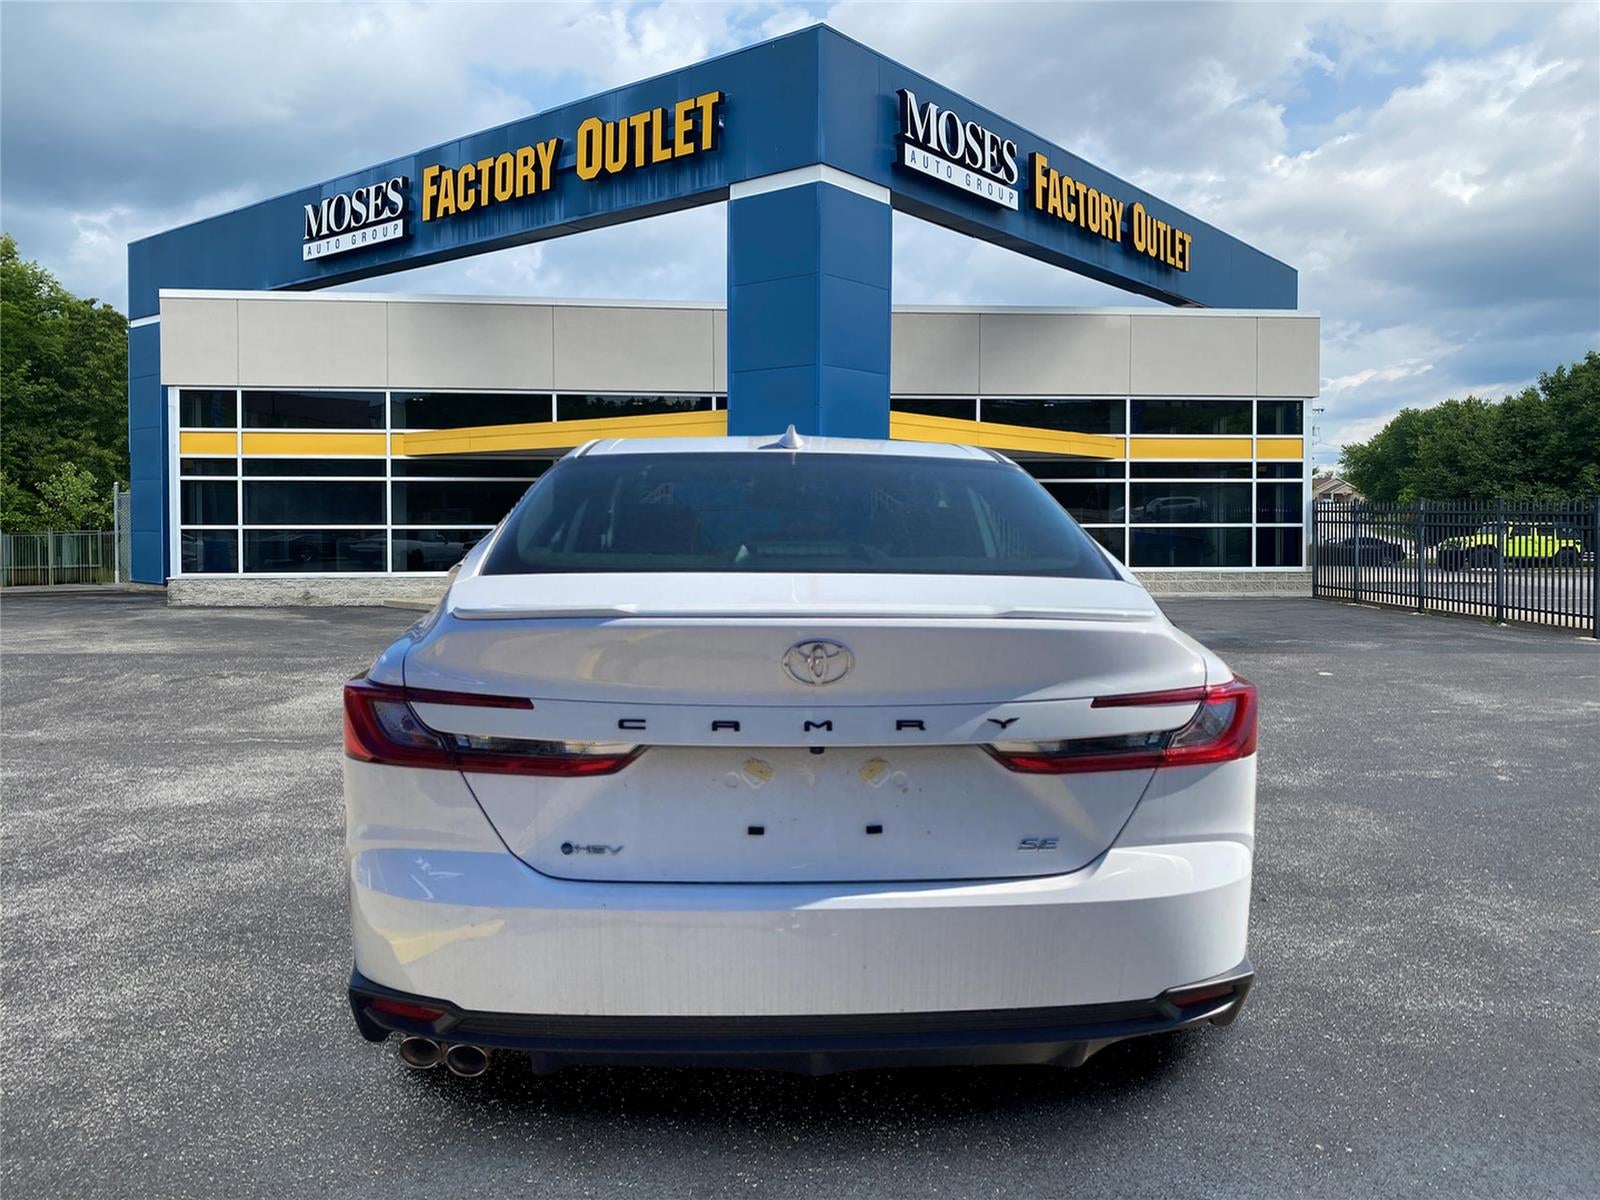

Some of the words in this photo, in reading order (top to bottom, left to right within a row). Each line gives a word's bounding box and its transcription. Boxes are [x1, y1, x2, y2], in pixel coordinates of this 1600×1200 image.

[422, 137, 561, 221] FACTORY
[576, 91, 720, 181] OUTLET
[904, 88, 1019, 185] MOSES
[910, 149, 953, 179] AUTO
[965, 168, 1015, 204] GROUP
[303, 176, 403, 240] MOSES
[1034, 151, 1124, 242] FACTORY
[1132, 202, 1192, 272] OUTLET
[307, 238, 340, 256] AUTO
[351, 223, 399, 245] GROUP
[618, 717, 1020, 732] CAMRY
[1017, 837, 1060, 851] SE
